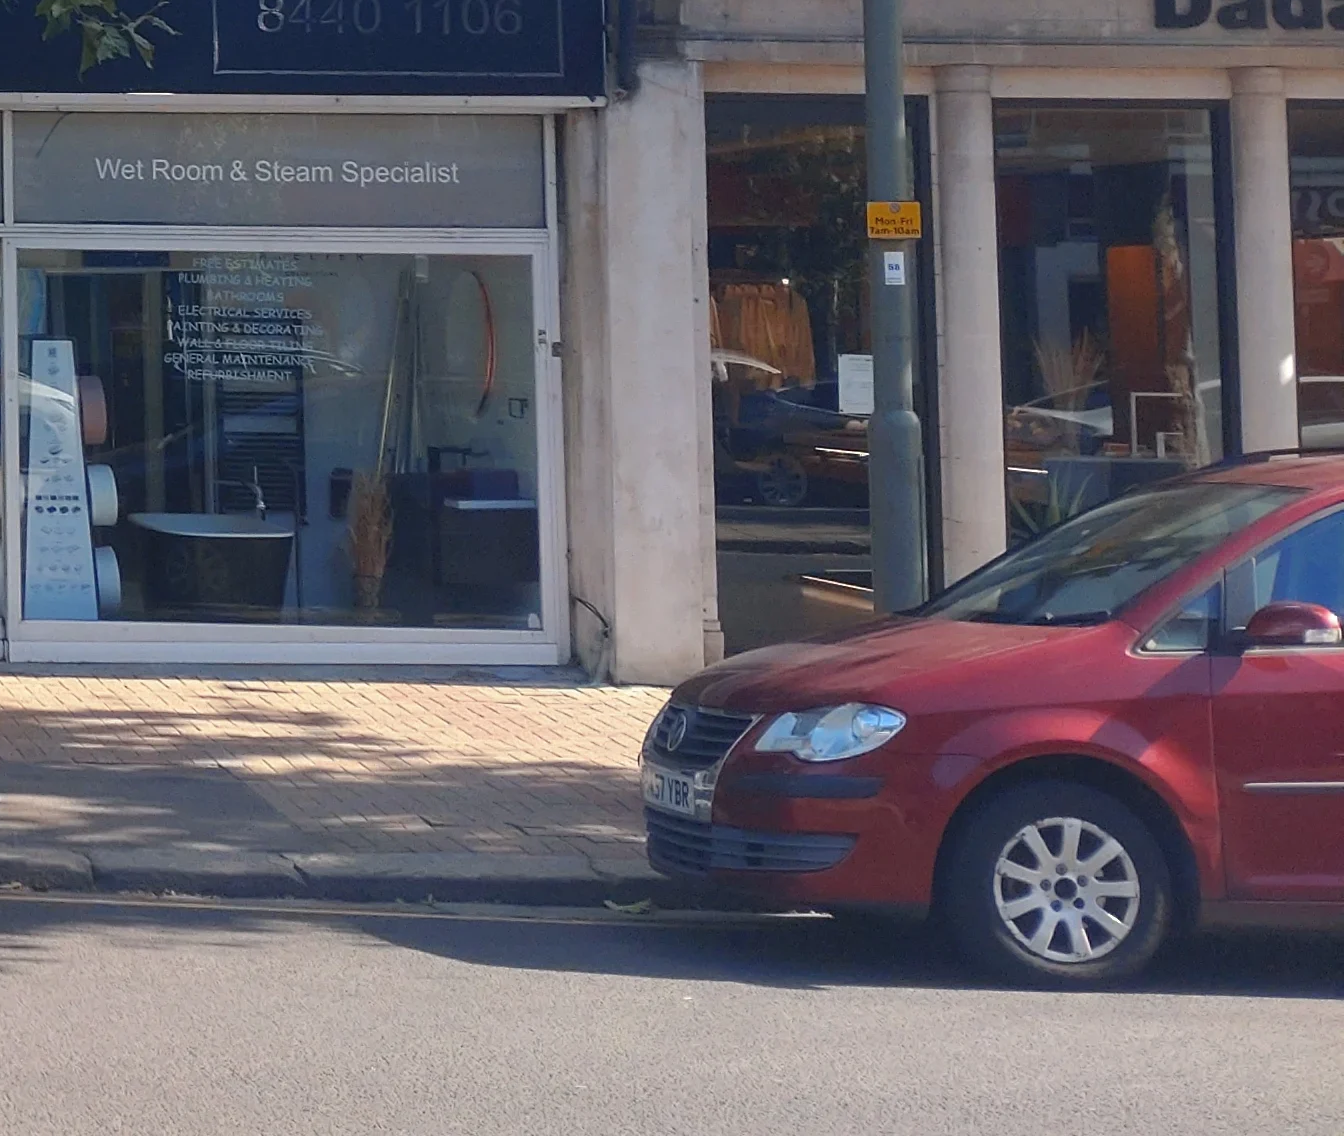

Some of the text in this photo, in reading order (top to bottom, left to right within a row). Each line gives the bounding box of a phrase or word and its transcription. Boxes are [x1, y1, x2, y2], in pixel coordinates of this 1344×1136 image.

[95, 158, 460, 187] Wet Room & Steam Specialist
[193, 257, 221, 269] FREE
[178, 273, 312, 287] PLUMBING & HEATING
[178, 305, 312, 320] ELECTRICAL SERVICES
[233, 323, 241, 333] &
[244, 324, 324, 336] DECORATING
[177, 338, 211, 349] WALL
[164, 352, 219, 365] GENERAL
[188, 369, 293, 381] REFURBISHMENT
[668, 776, 690, 808] YBR
